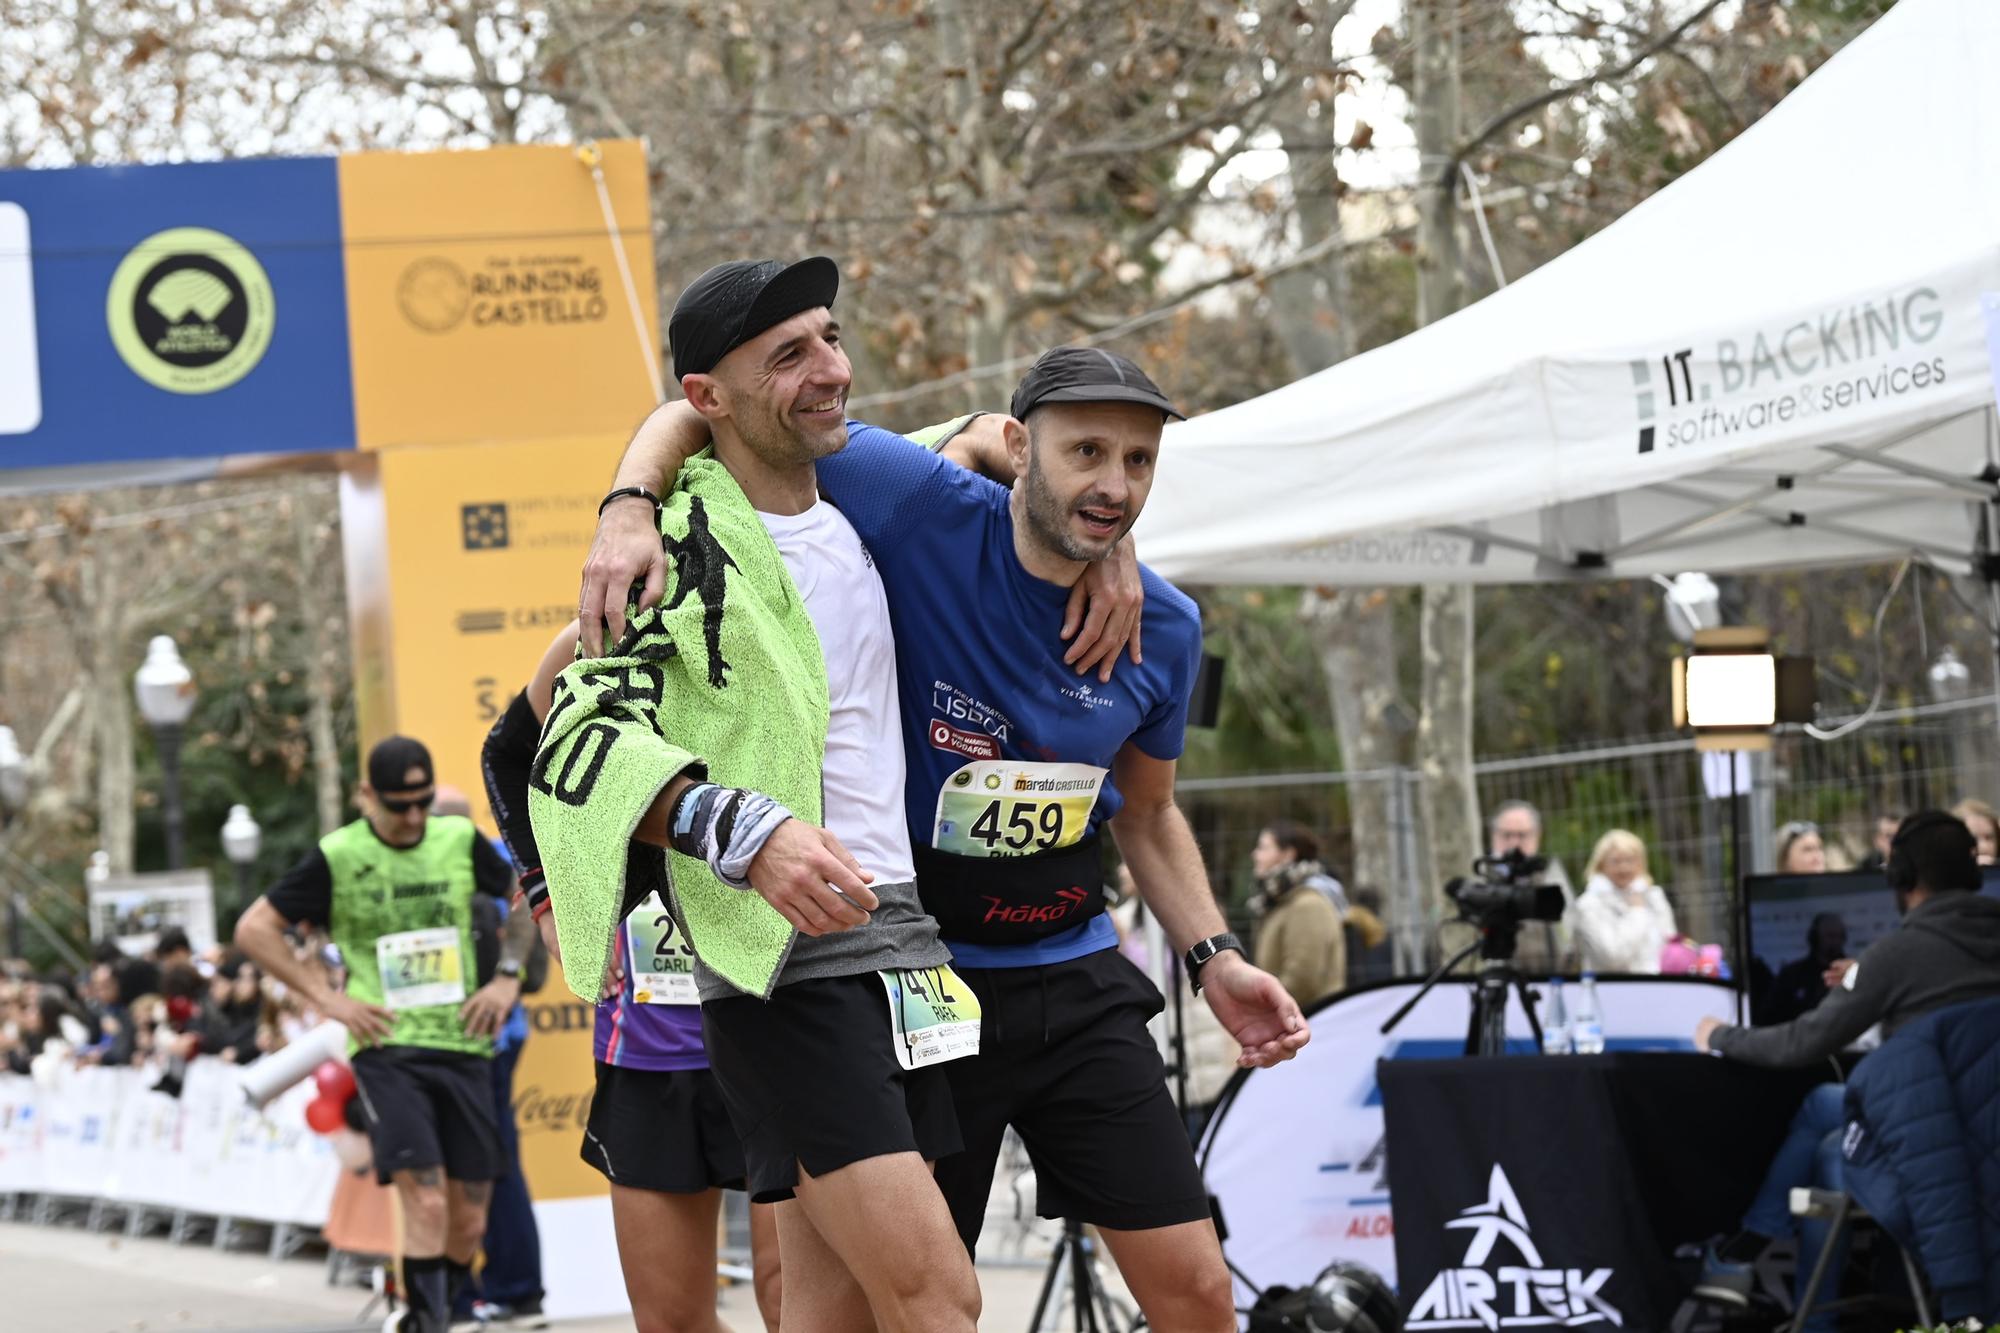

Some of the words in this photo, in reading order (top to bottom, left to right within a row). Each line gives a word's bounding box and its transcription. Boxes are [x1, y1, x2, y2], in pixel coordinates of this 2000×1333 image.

[472, 267, 600, 296] RUNNING
[951, 738, 993, 757] VODAFONE
[1014, 778, 1055, 791] marató
[1055, 777, 1096, 791] CASTELLÓ
[969, 800, 1063, 849] 459
[399, 949, 442, 979] 277
[652, 958, 693, 973] CARL
[903, 967, 956, 1003] 412
[931, 1006, 960, 1021] RAFA
